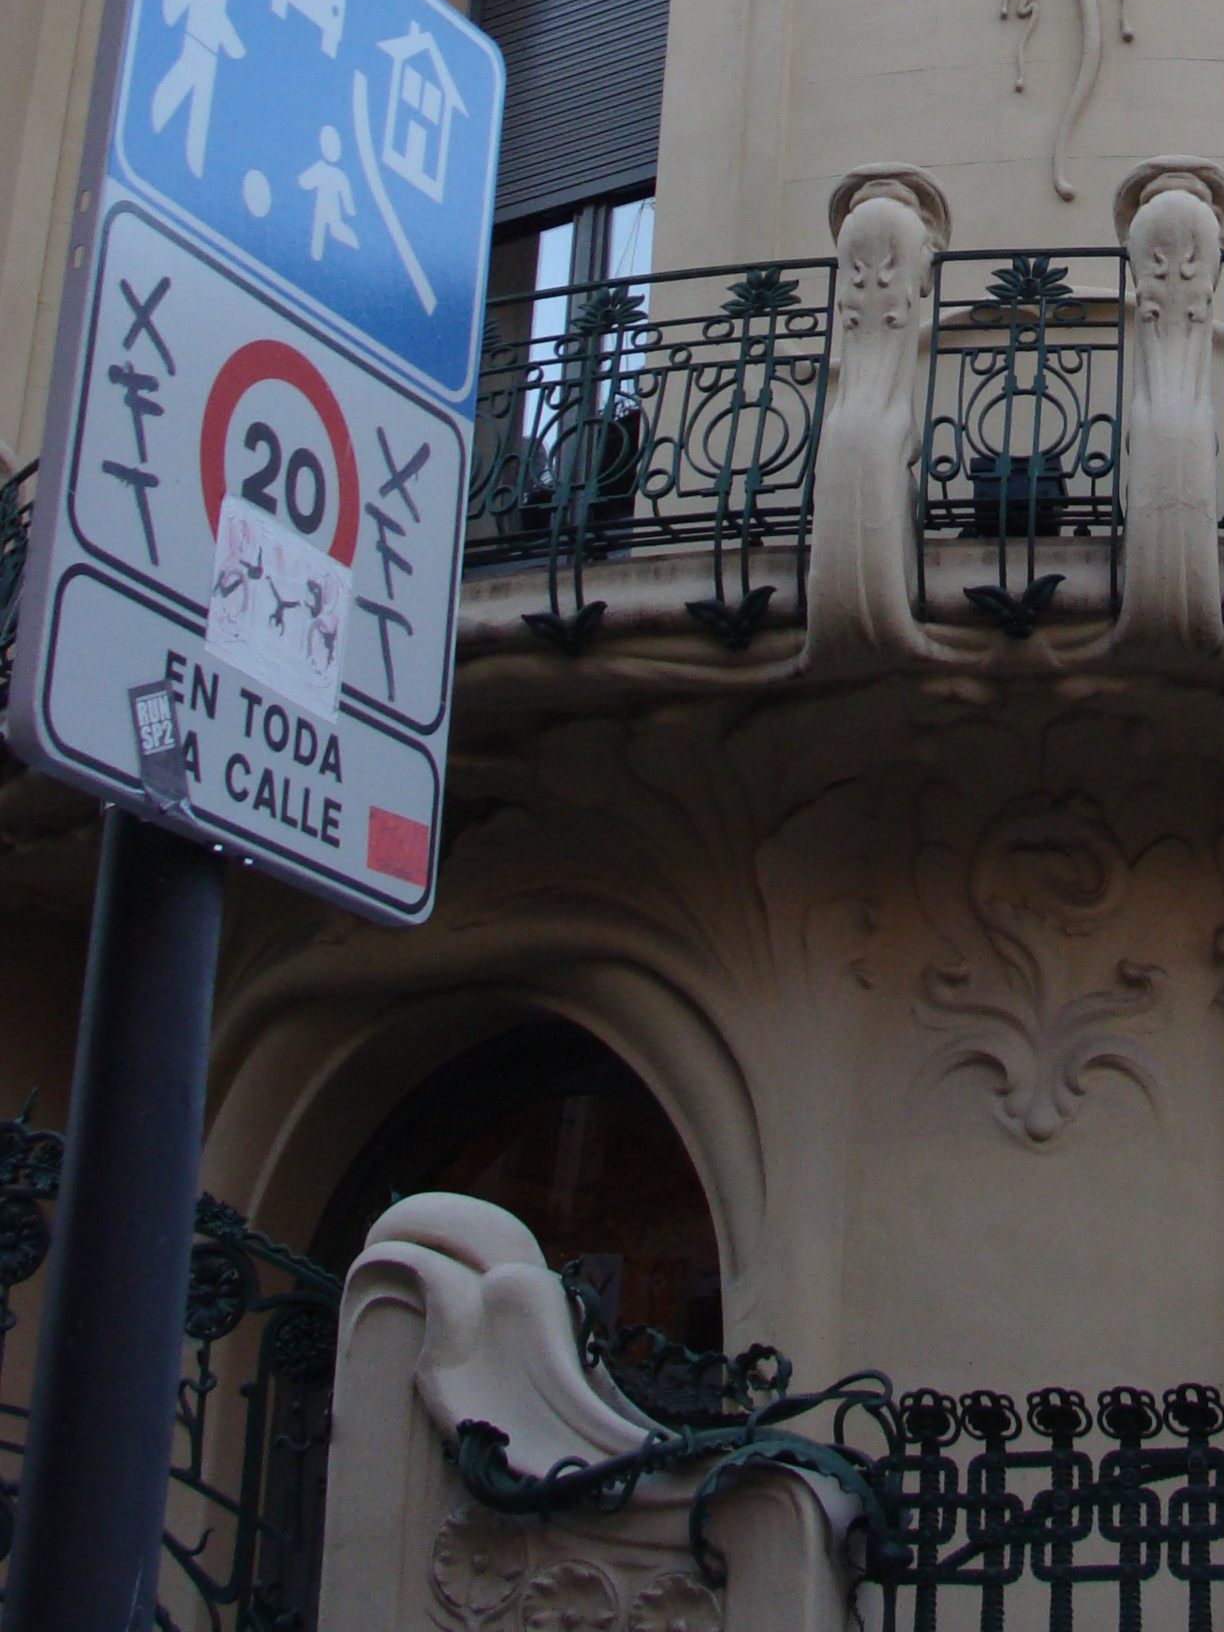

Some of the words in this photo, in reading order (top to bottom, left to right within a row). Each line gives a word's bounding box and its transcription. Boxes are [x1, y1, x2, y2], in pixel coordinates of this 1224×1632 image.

[241, 421, 326, 535] 20
[137, 694, 171, 727] RUN
[140, 720, 175, 750] SP2
[165, 649, 219, 720] EN
[240, 687, 342, 783] TODA
[225, 752, 342, 849] CALLE
